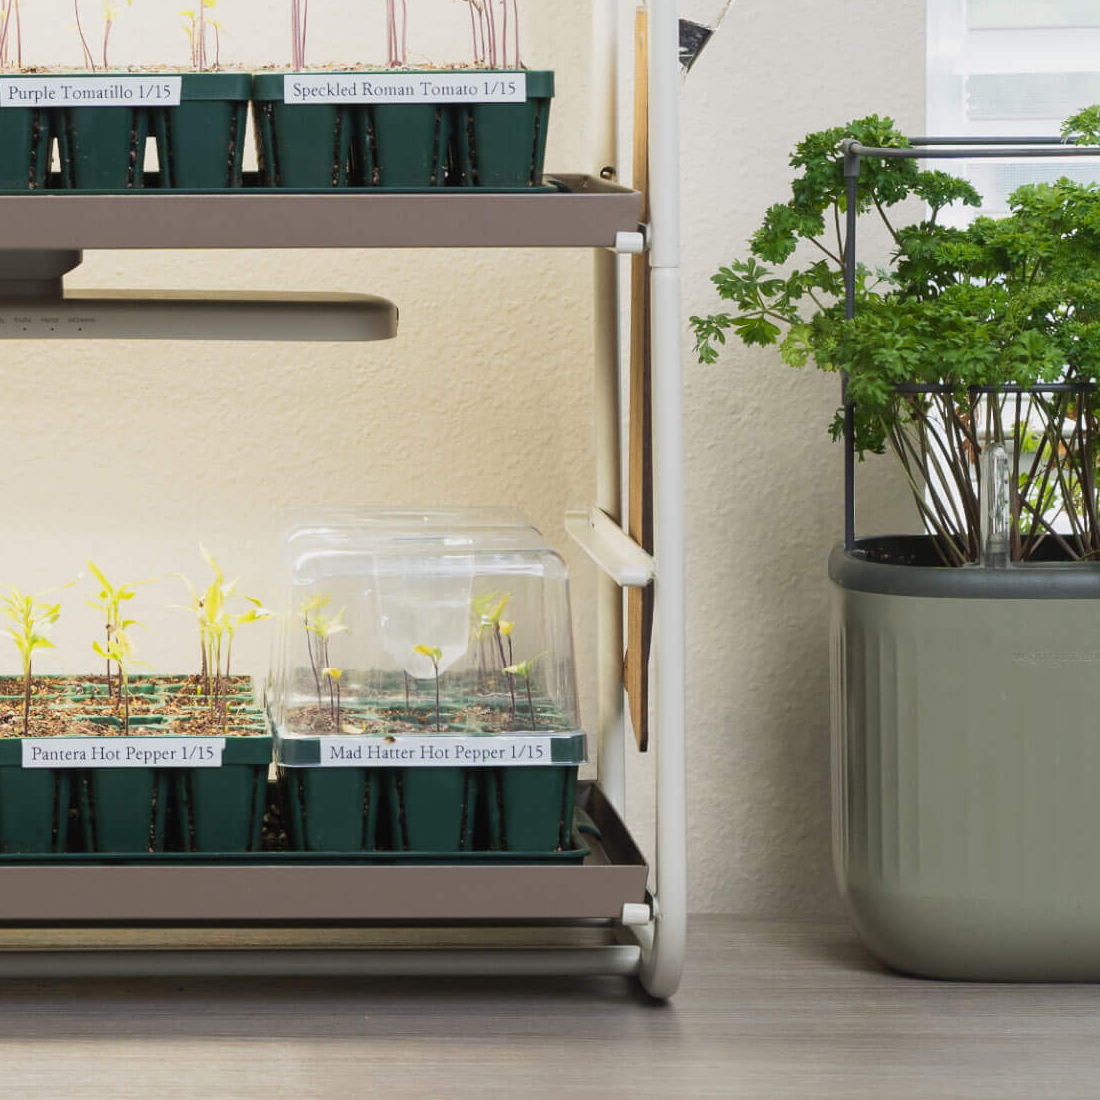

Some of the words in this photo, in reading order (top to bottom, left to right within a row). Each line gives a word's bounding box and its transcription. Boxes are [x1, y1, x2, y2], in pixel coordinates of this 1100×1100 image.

[9, 85, 56, 105] Purple
[60, 84, 133, 100] Tomatillo
[139, 84, 171, 99] 1/15
[293, 81, 357, 100] Speckled
[362, 82, 414, 96] Roman
[419, 81, 478, 96] Tomato
[484, 81, 516, 96] 1/15
[31, 746, 87, 761] Pantera
[91, 746, 120, 761] Hot
[125, 746, 177, 765] Pepper
[182, 746, 214, 760] 1/15
[329, 745, 363, 760] Mad
[367, 745, 415, 760] Hatter
[419, 745, 450, 760] Hot
[455, 744, 506, 763] Pepper
[511, 744, 544, 759] 1/15
